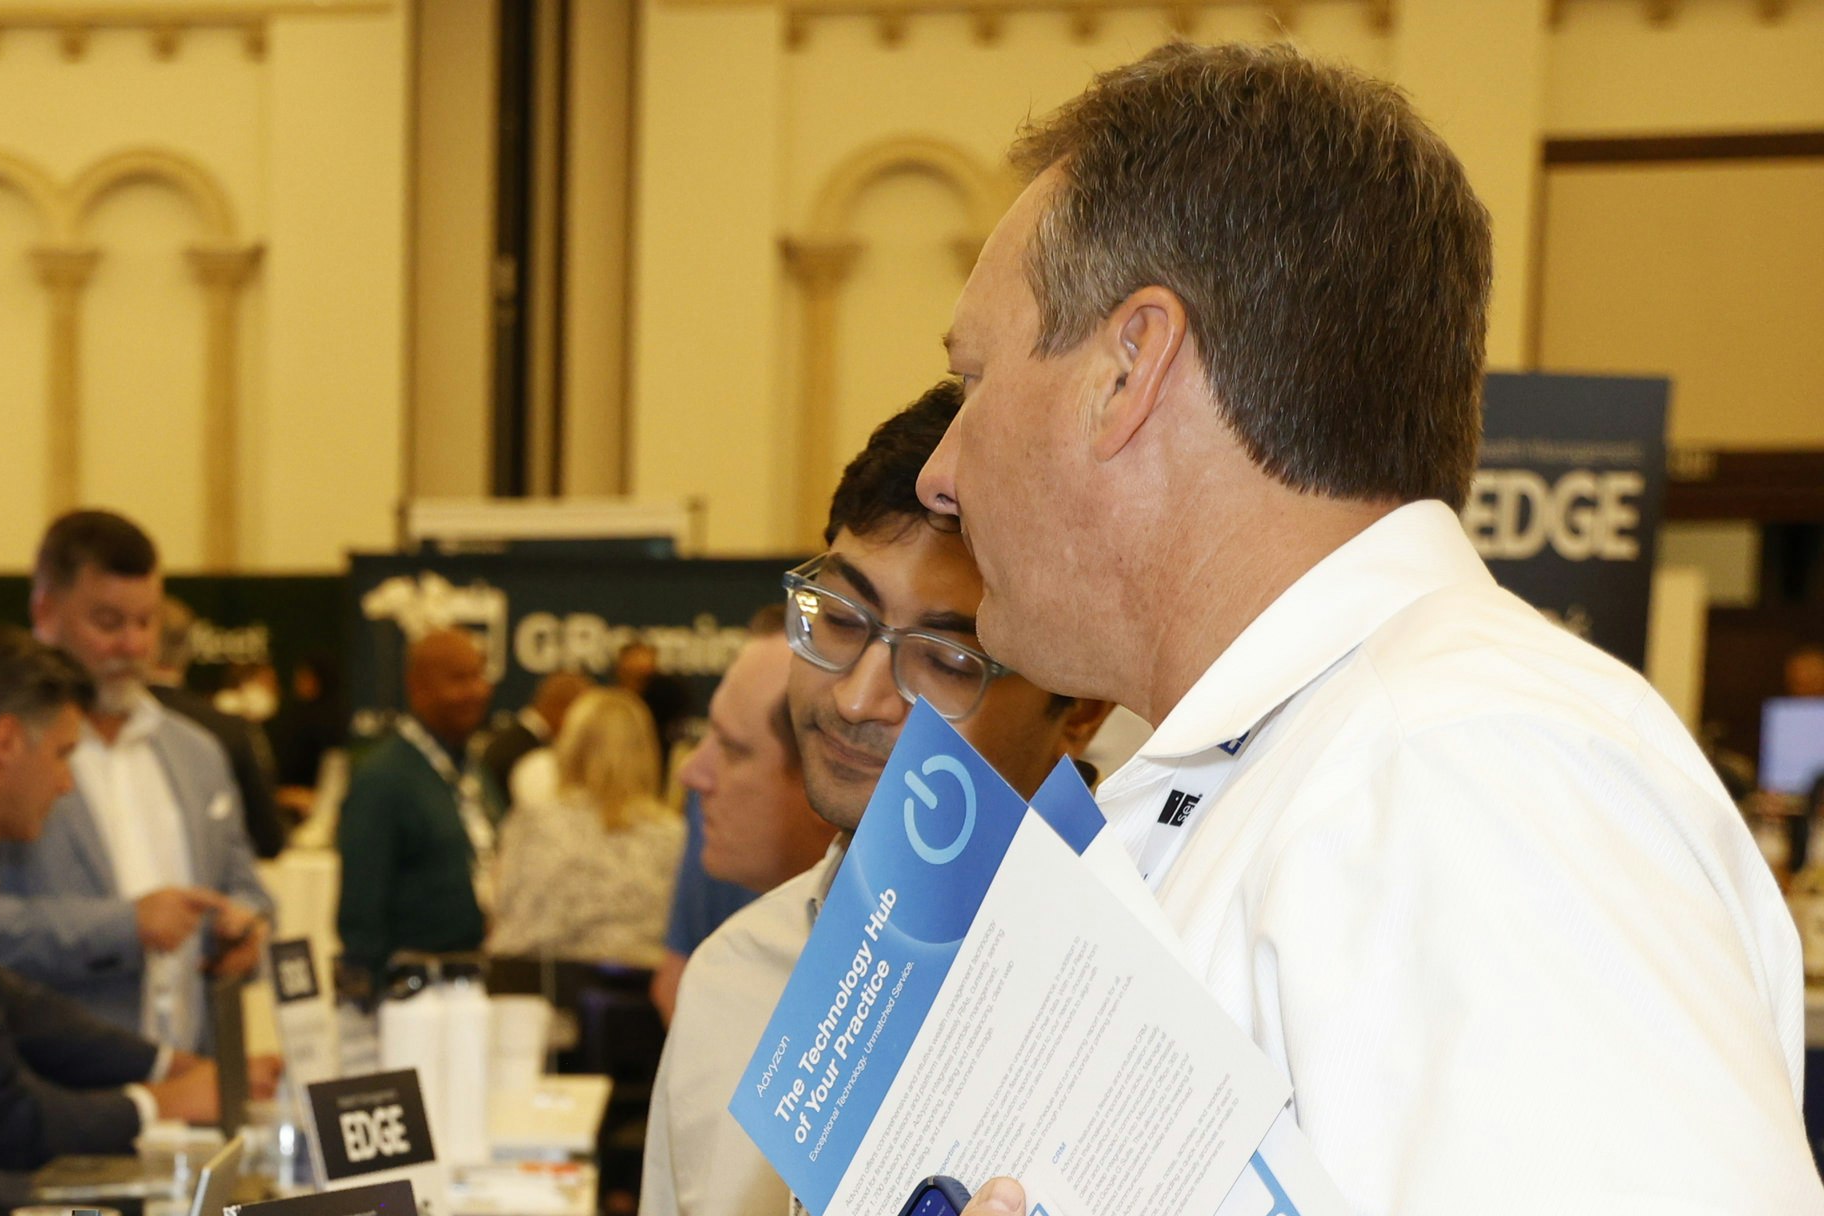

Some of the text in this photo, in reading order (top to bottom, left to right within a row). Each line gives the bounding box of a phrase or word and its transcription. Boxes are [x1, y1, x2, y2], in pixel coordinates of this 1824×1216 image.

[1464, 469, 1645, 561] EDGE
[773, 881, 899, 1129] The Technology Hub
[790, 952, 891, 1148] of Your Practice
[754, 1030, 792, 1101] Advyzon
[808, 956, 915, 1165] Exceptional Technology. Unmatched Service.
[339, 1104, 411, 1163] EDGE
[1050, 1139, 1067, 1166] CRM
